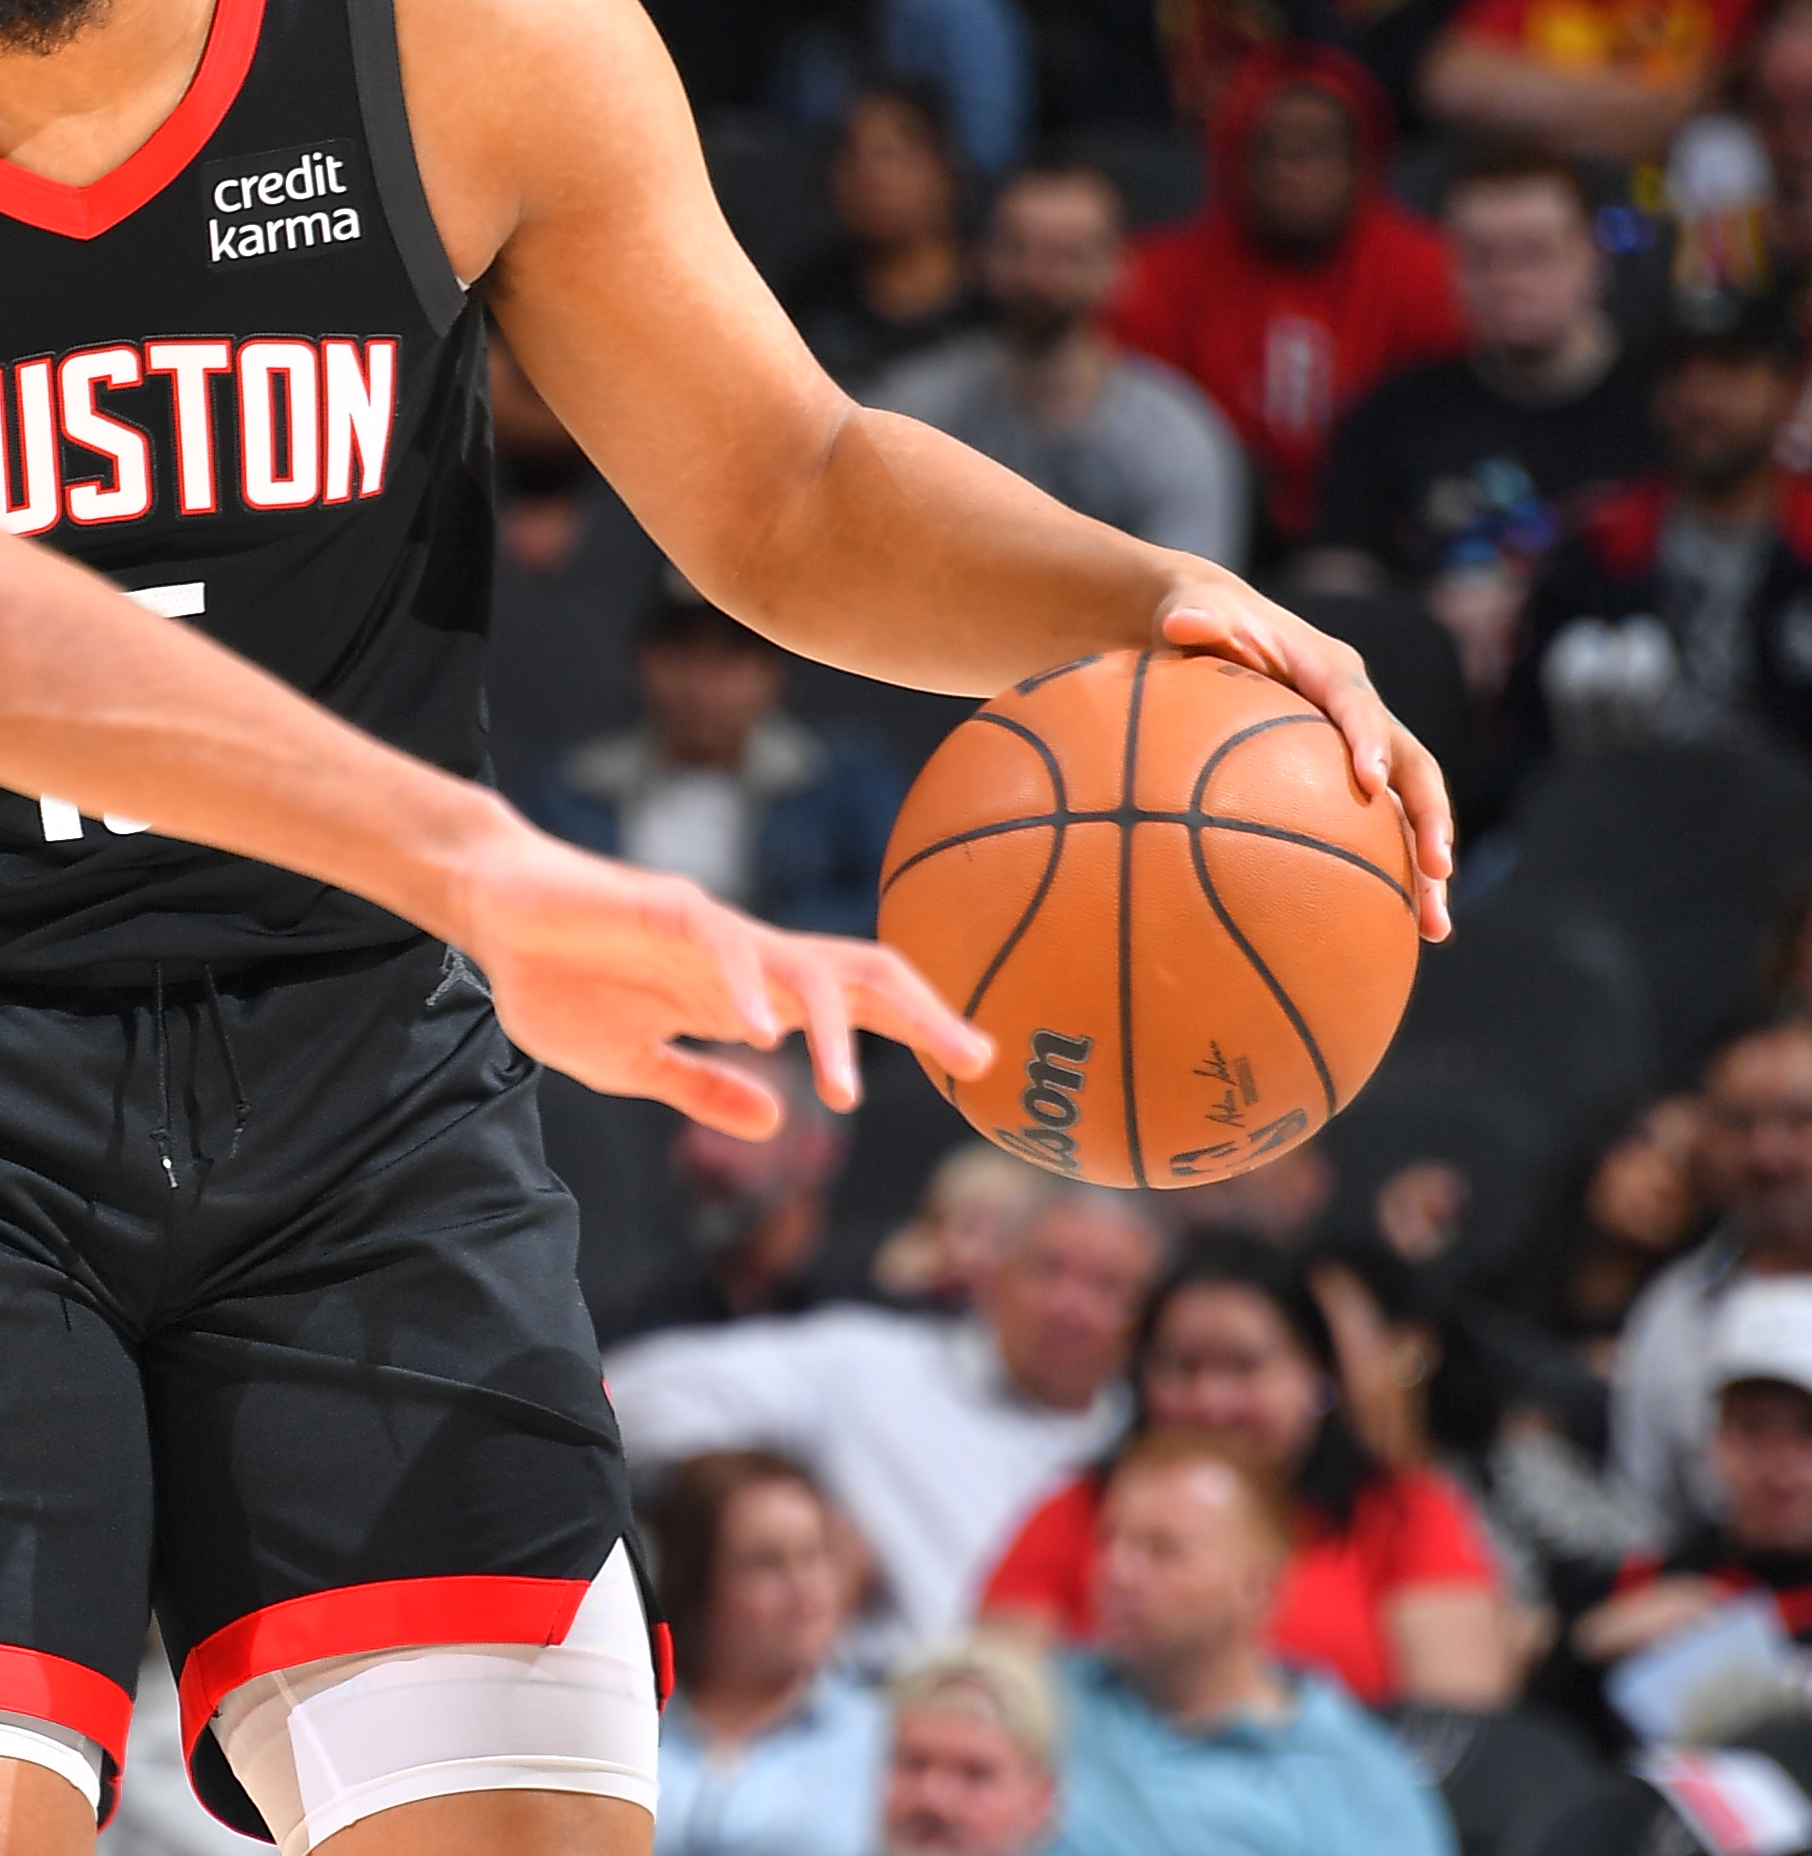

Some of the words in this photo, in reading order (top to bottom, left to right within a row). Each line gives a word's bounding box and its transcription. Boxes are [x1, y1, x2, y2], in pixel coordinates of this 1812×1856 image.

[212, 152, 346, 214] credit
[208, 204, 362, 264] karma
[994, 1028, 1093, 1170] lson
